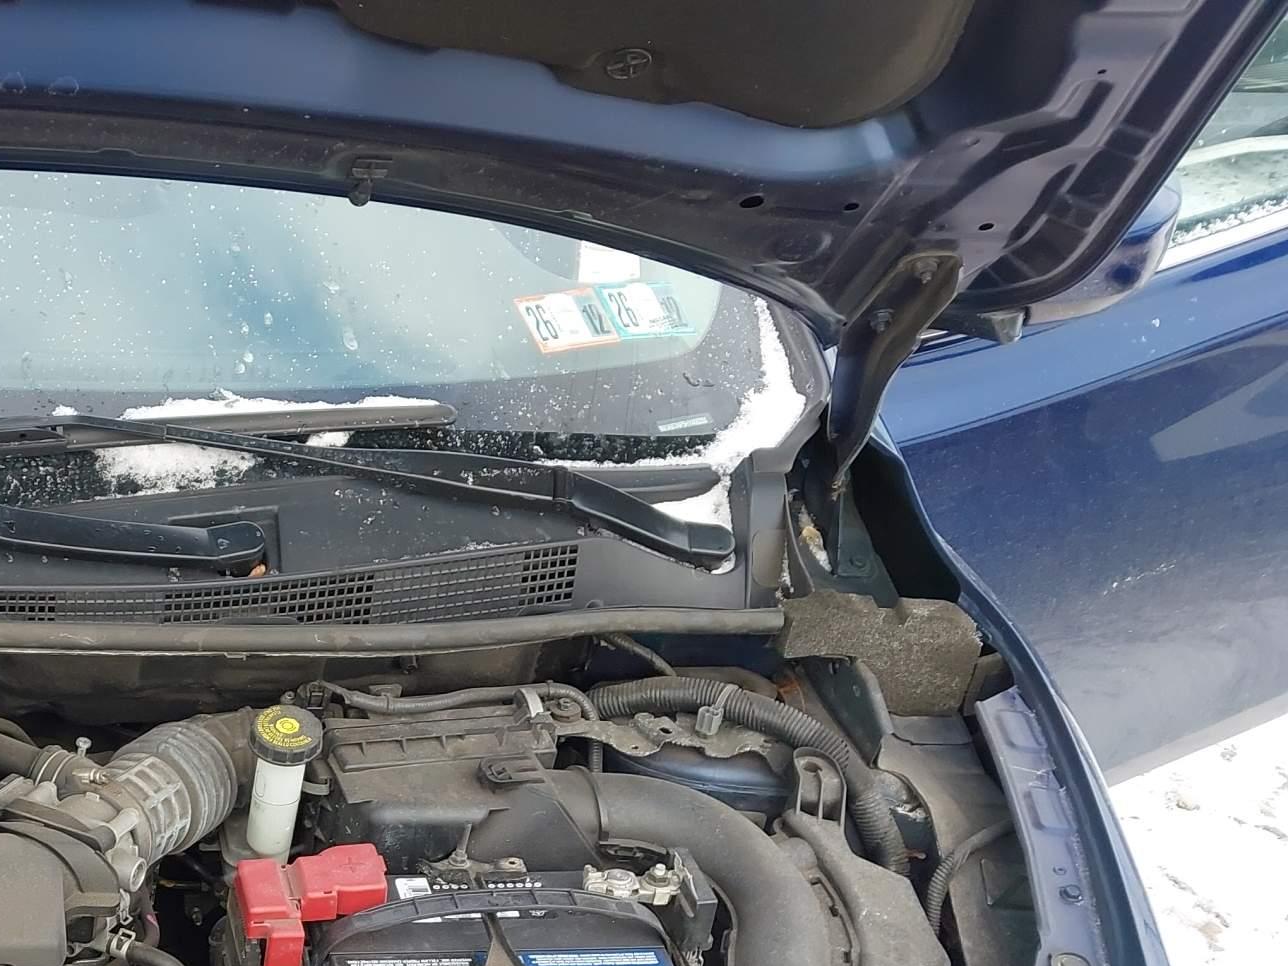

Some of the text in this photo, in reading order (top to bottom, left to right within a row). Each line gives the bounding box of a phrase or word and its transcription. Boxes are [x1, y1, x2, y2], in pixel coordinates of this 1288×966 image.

[525, 303, 559, 342] 26
[582, 303, 611, 336] 12
[607, 291, 640, 328] 26
